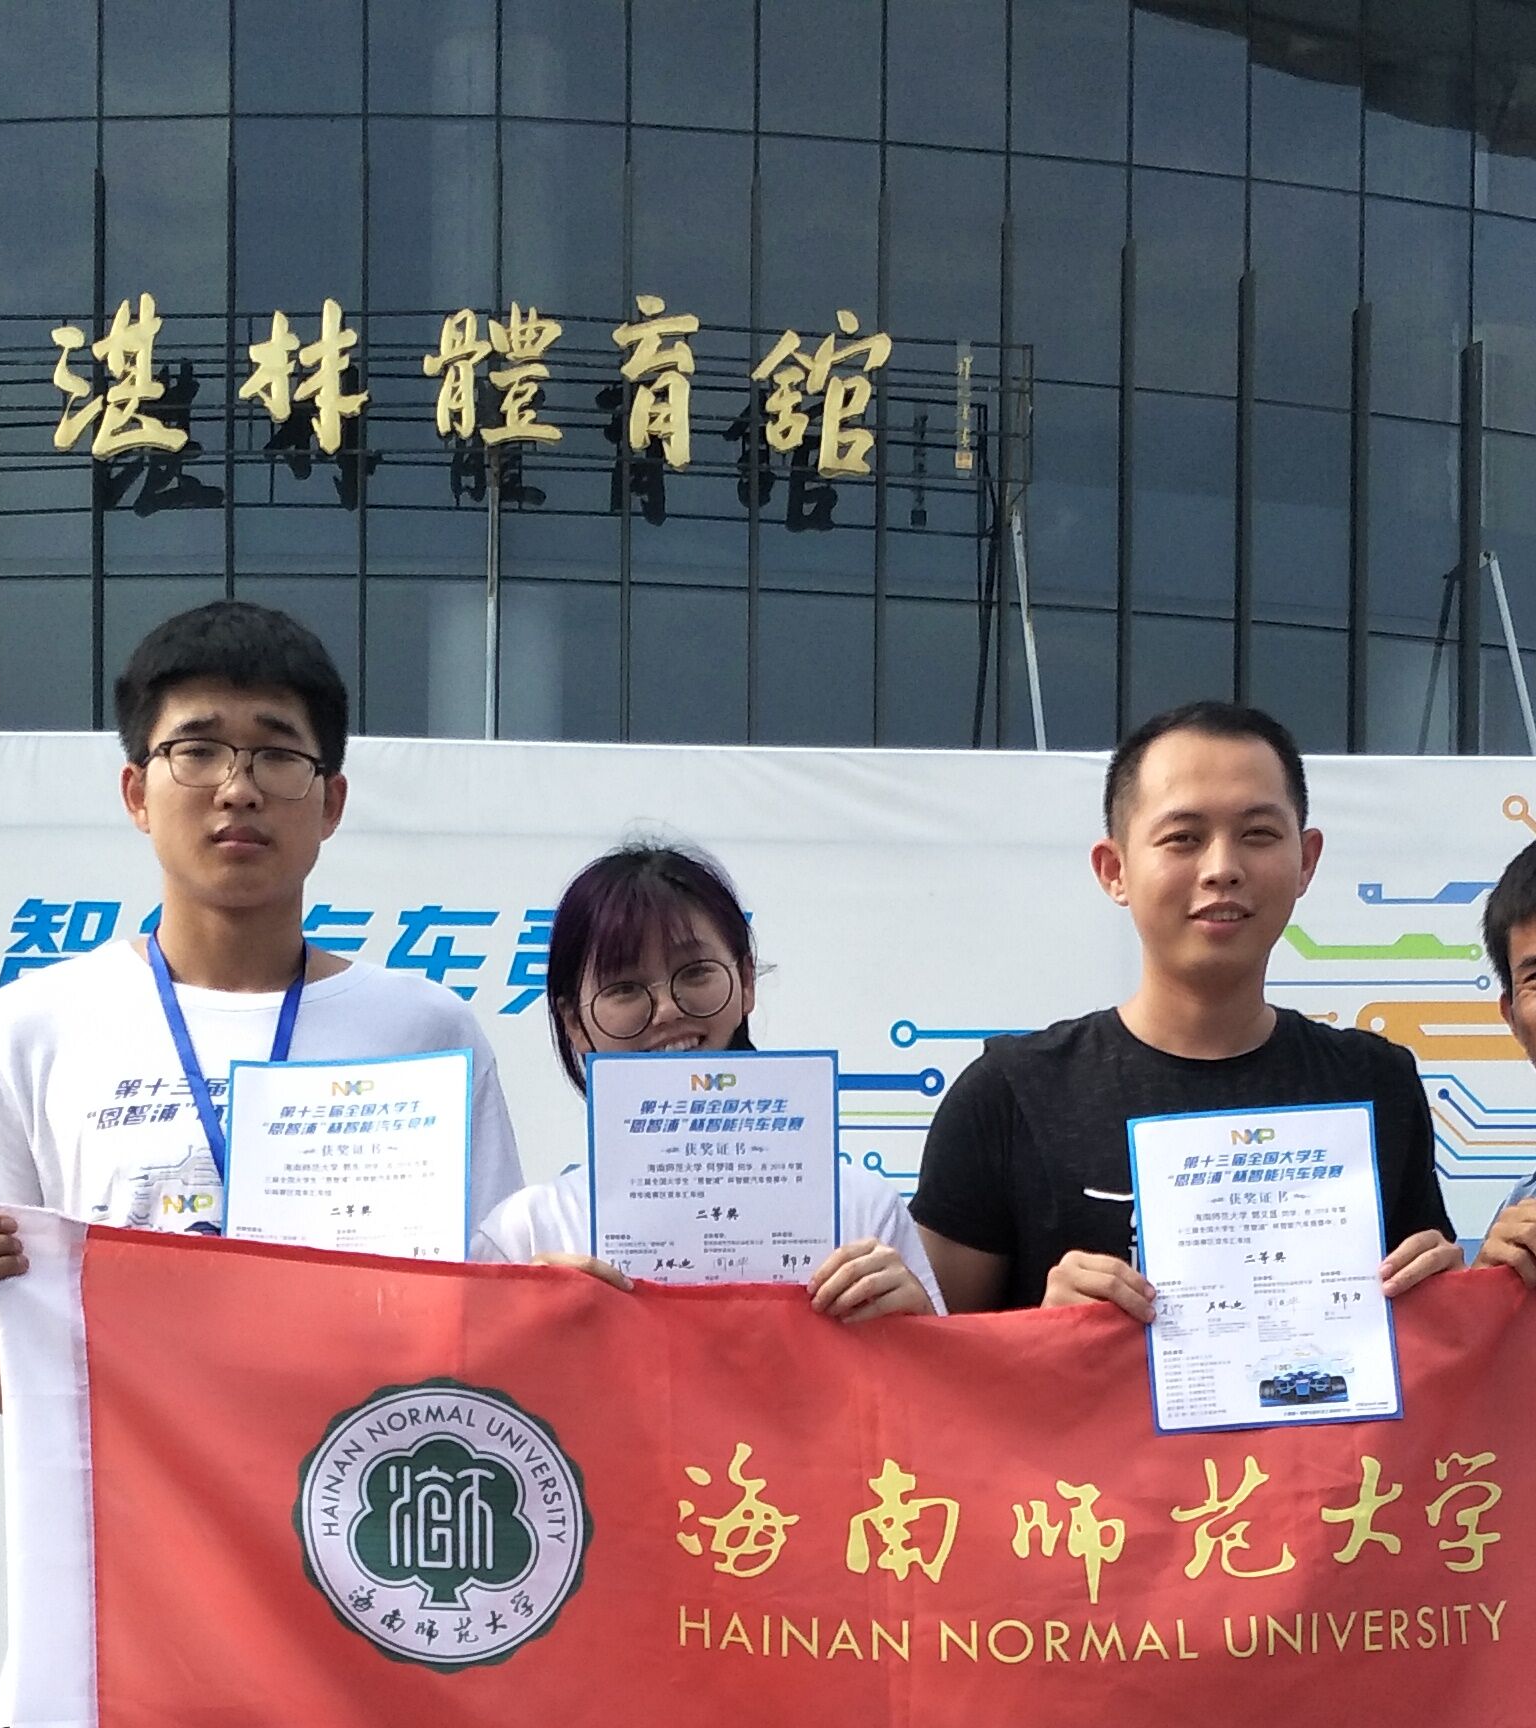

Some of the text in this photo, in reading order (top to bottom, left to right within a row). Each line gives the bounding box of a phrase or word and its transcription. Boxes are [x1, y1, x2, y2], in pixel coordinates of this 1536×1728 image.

[331, 1080, 375, 1097] NXP
[690, 1073, 737, 1092] NXP
[639, 1098, 788, 1116] 第十三届全国大学生
[1230, 1128, 1275, 1146] NXP
[162, 1193, 214, 1215] NXP
[322, 1404, 567, 1544] HAINAN NORMAL UNIVERSITY
[676, 1442, 1504, 1605] 海南师范大学
[677, 1600, 1508, 1663] HAINAN NORMAL UNIVERSITY
